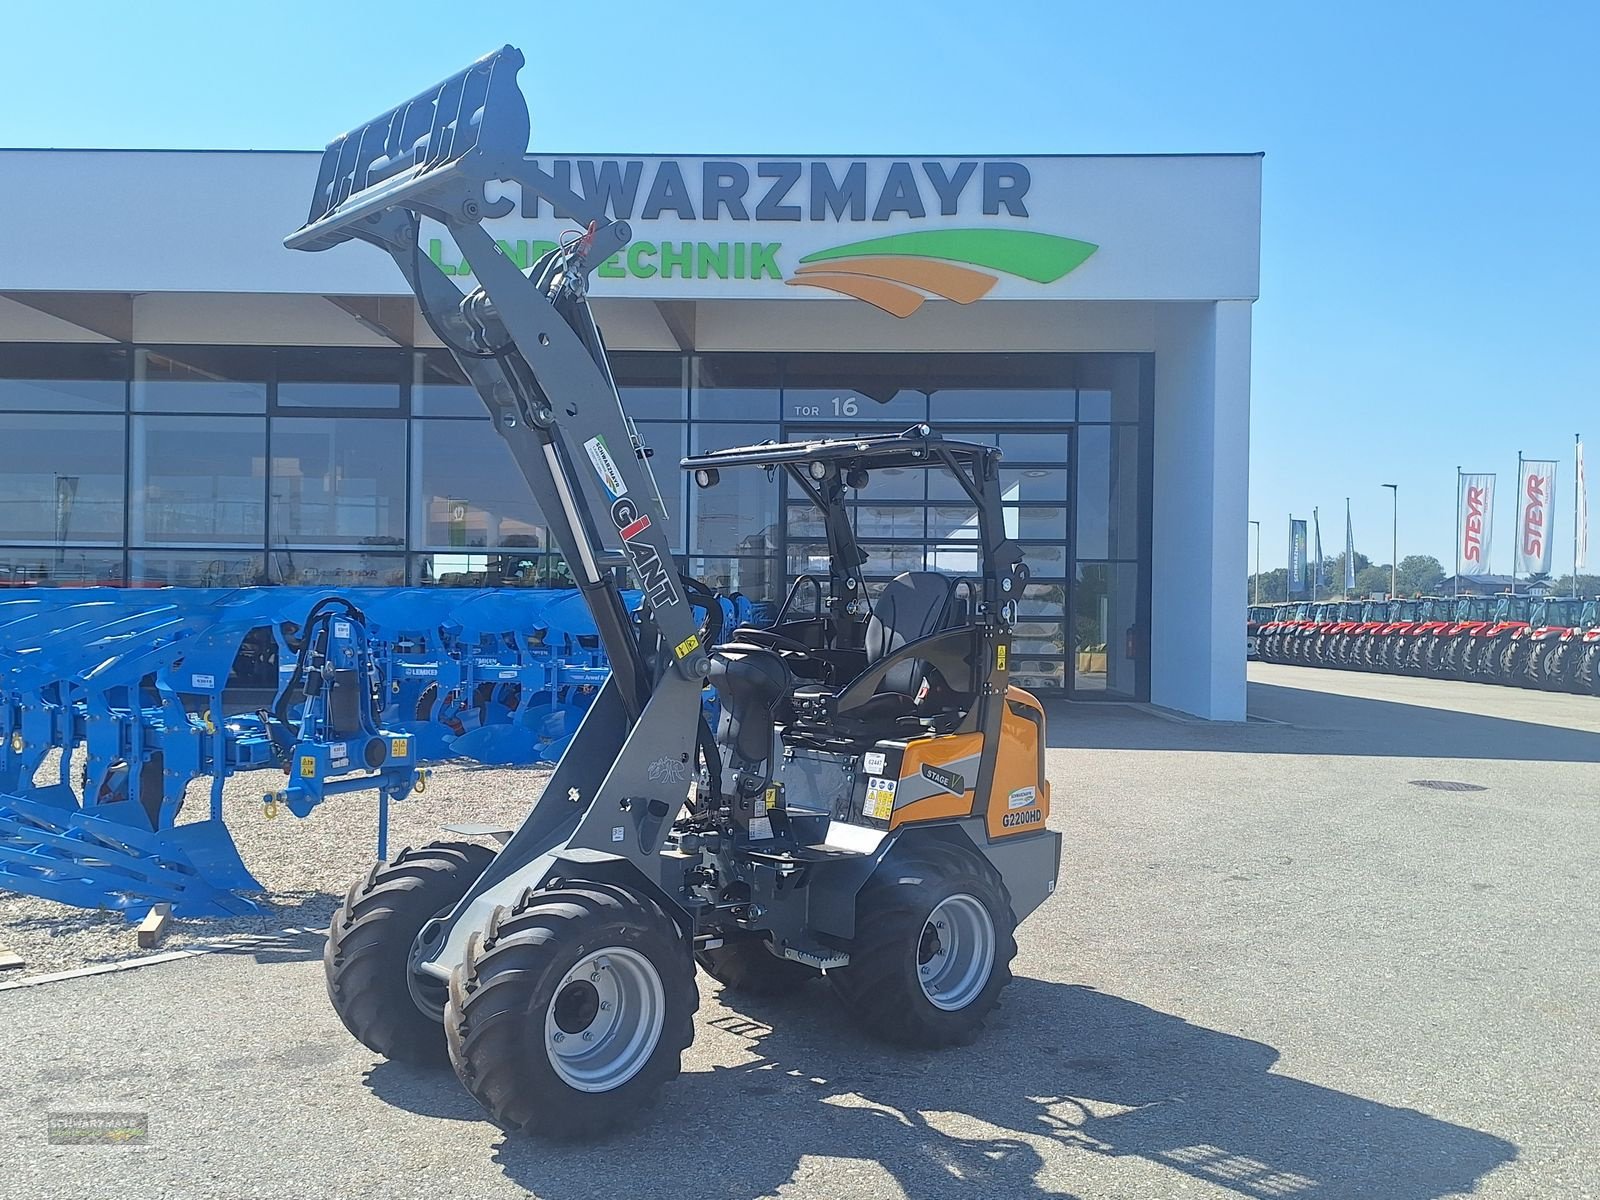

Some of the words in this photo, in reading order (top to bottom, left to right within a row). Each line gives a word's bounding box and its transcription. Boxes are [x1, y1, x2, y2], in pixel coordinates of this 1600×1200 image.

[479, 159, 1031, 222] CHWARZMAYR
[429, 238, 782, 280] LNECHNIK
[794, 406, 820, 416] TOR
[831, 397, 858, 417] 16
[595, 442, 620, 488] SCHWARZMAYR
[1464, 486, 1484, 563] STEYR
[1524, 474, 1545, 559] STEYR
[611, 497, 679, 609] GIANT
[926, 769, 950, 786] STAGE
[951, 774, 961, 788] V
[1002, 809, 1042, 828] G2200HD
